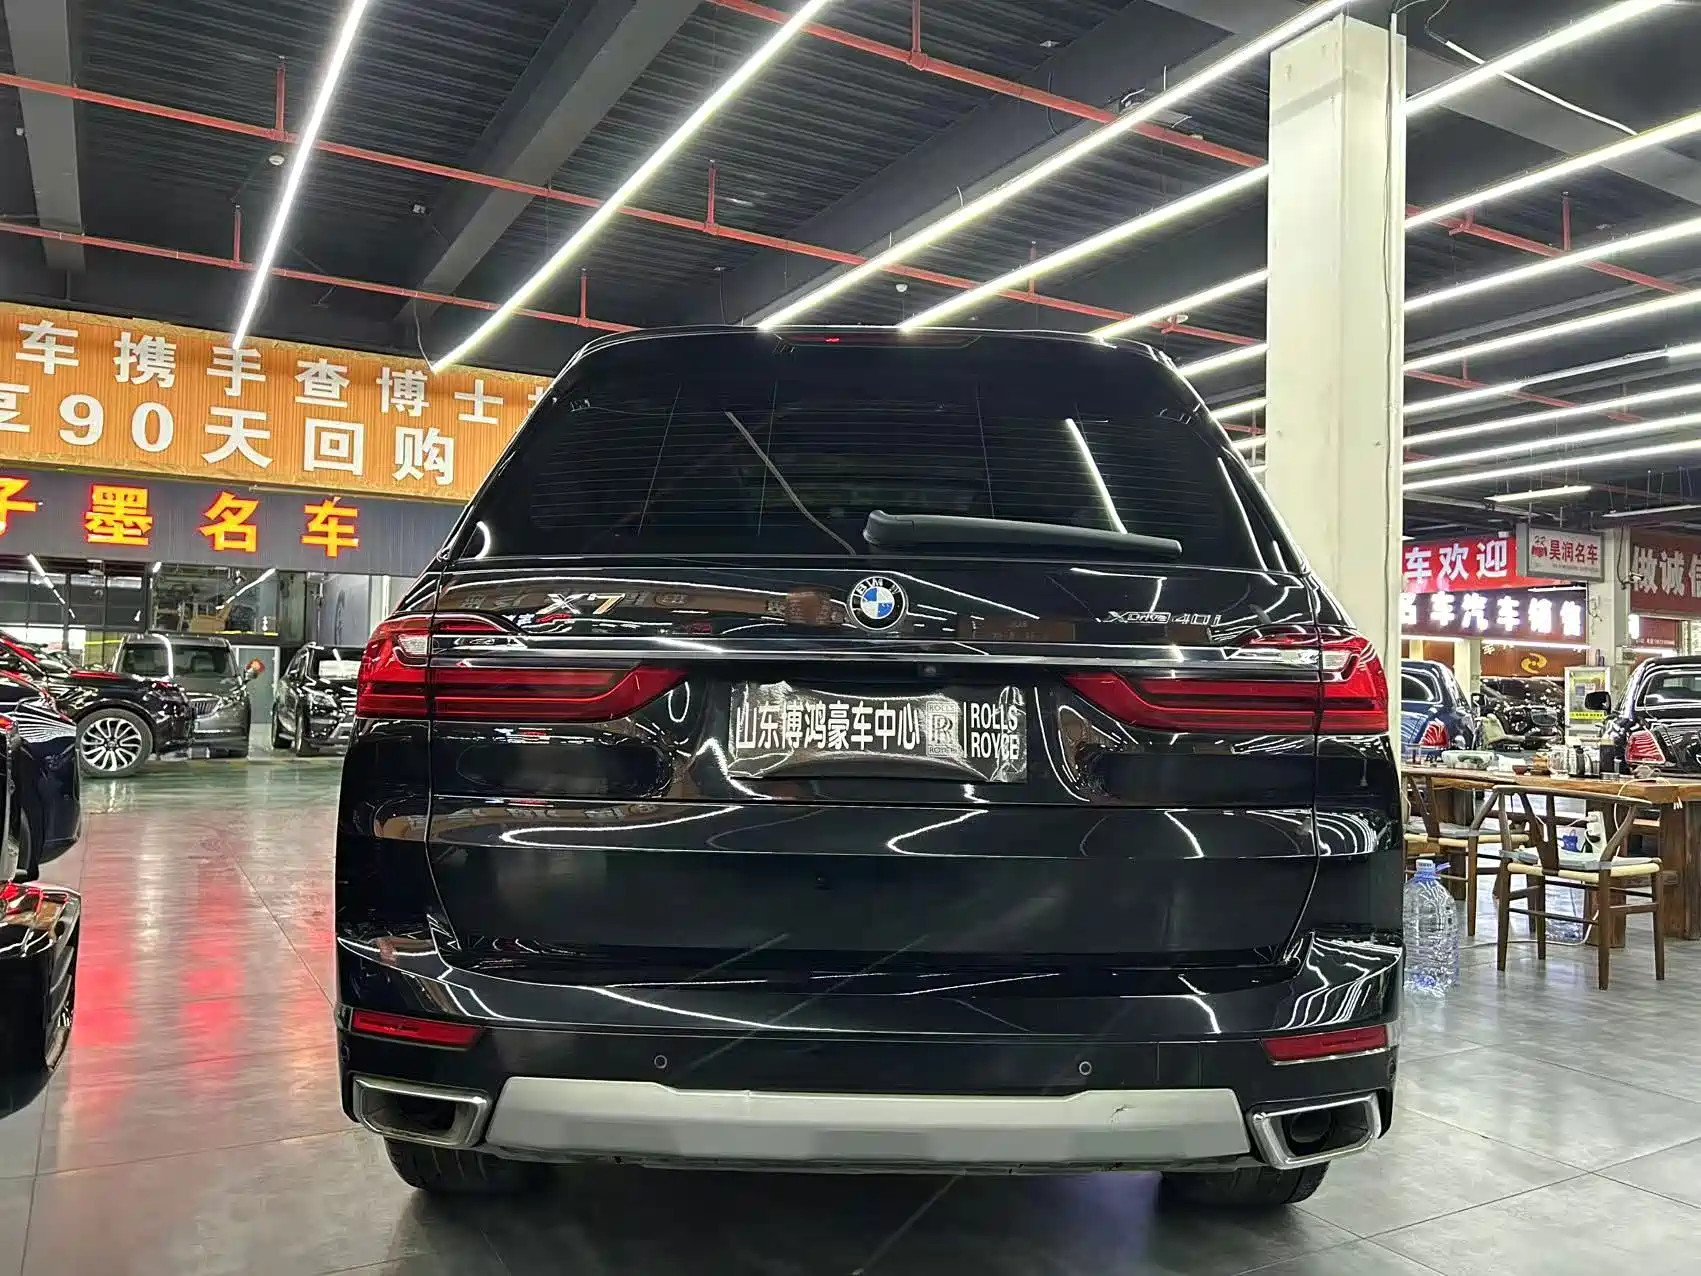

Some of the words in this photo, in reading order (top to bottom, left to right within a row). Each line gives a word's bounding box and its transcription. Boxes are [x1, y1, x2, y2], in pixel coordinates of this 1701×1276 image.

[15, 320, 545, 425] 车携手查博士
[1403, 540, 1508, 585] 车欢迎
[1550, 540, 1598, 565] 昊润名车
[535, 592, 626, 615] X7
[735, 700, 921, 751] 山东博鸿豪车中心
[970, 702, 1018, 732] ROLLS
[970, 731, 1021, 760] ROYCE
